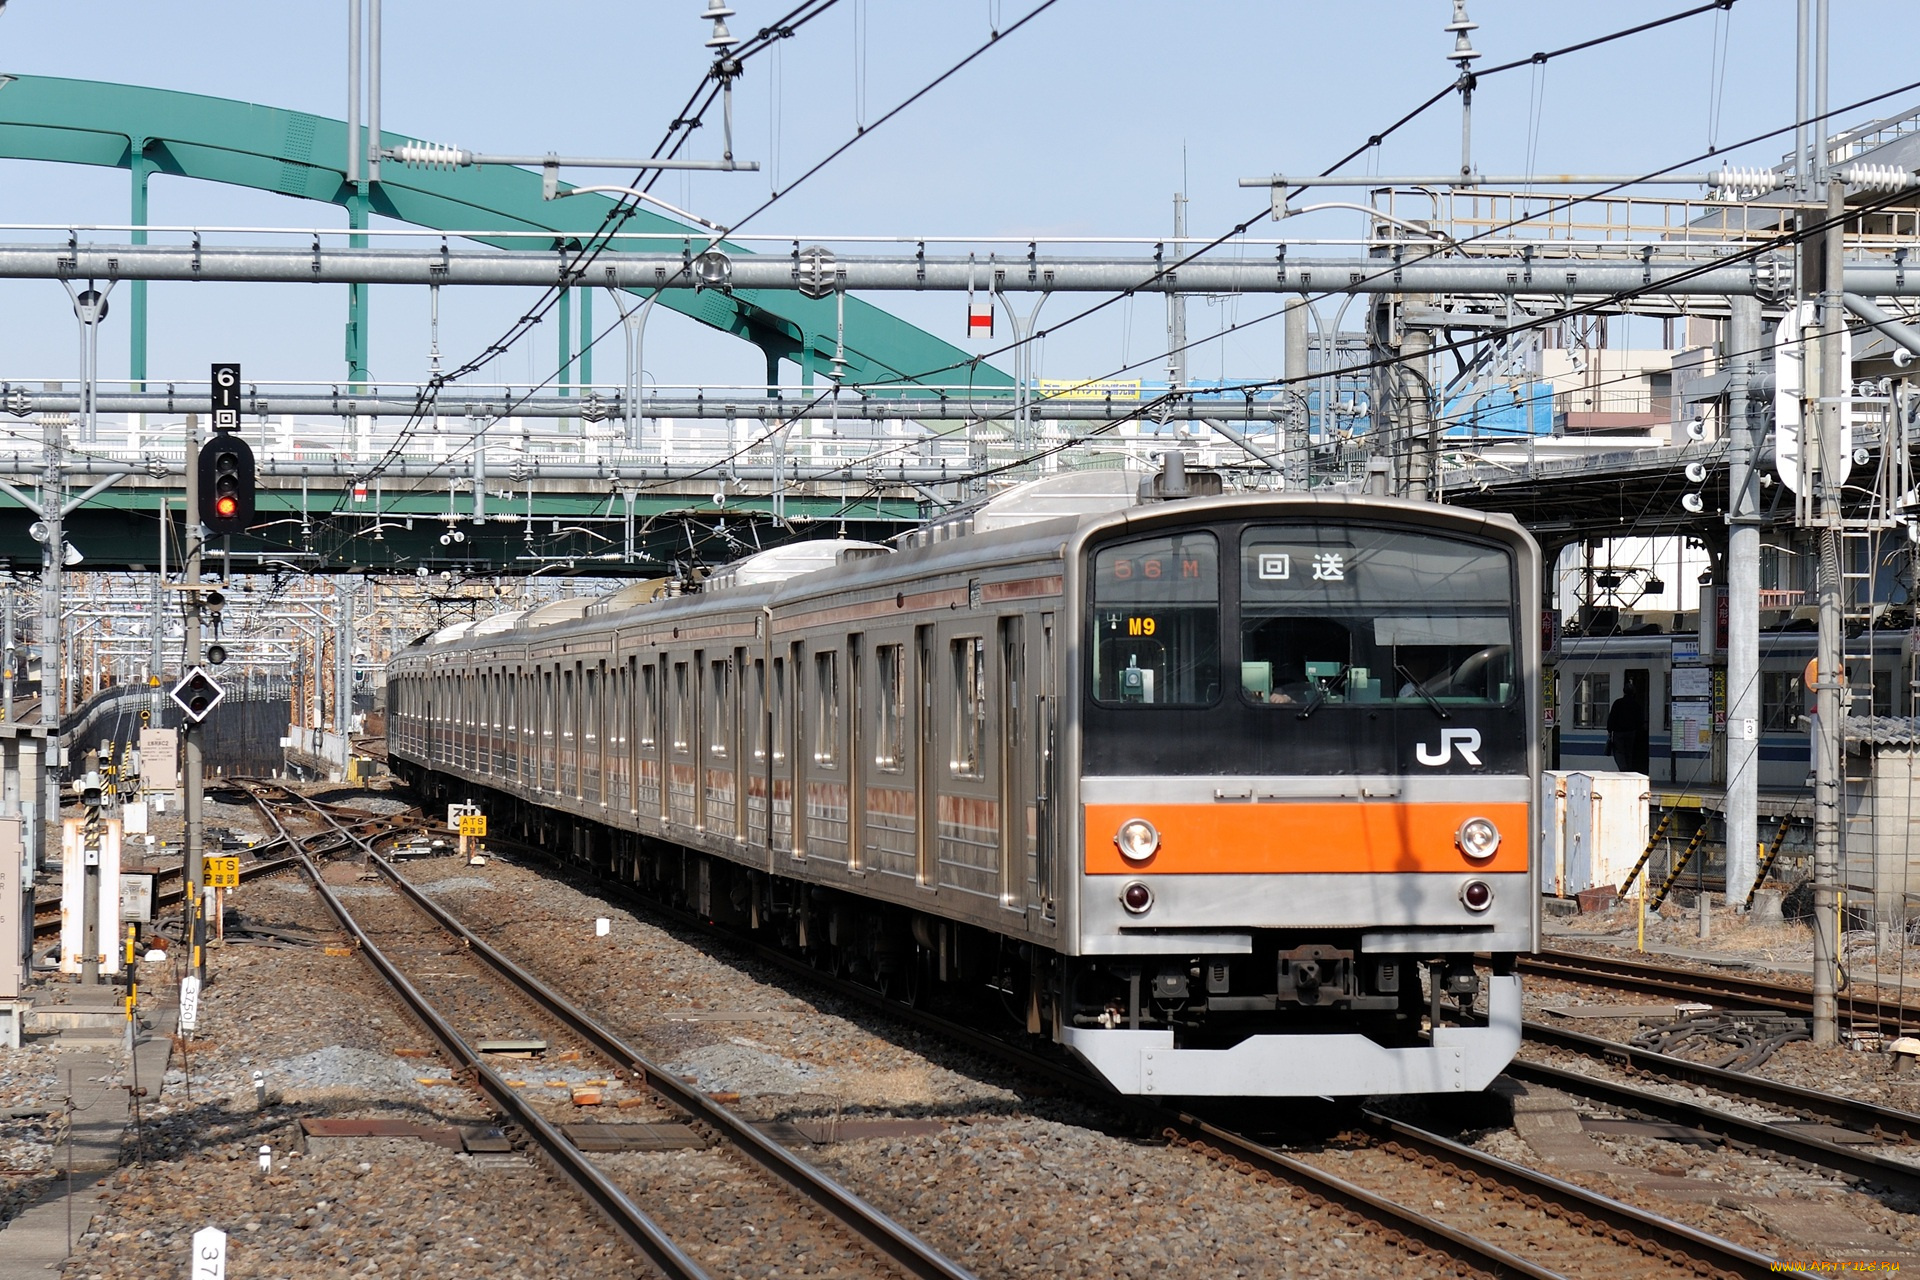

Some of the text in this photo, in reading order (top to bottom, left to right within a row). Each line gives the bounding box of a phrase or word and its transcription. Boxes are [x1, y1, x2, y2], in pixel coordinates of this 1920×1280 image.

[1259, 553, 1345, 581] 回送
[1129, 618, 1156, 635] M9
[1416, 728, 1482, 766] JR
[203, 860, 235, 871] ATS
[203, 874, 235, 885] P確認
[182, 987, 195, 1020] 3750
